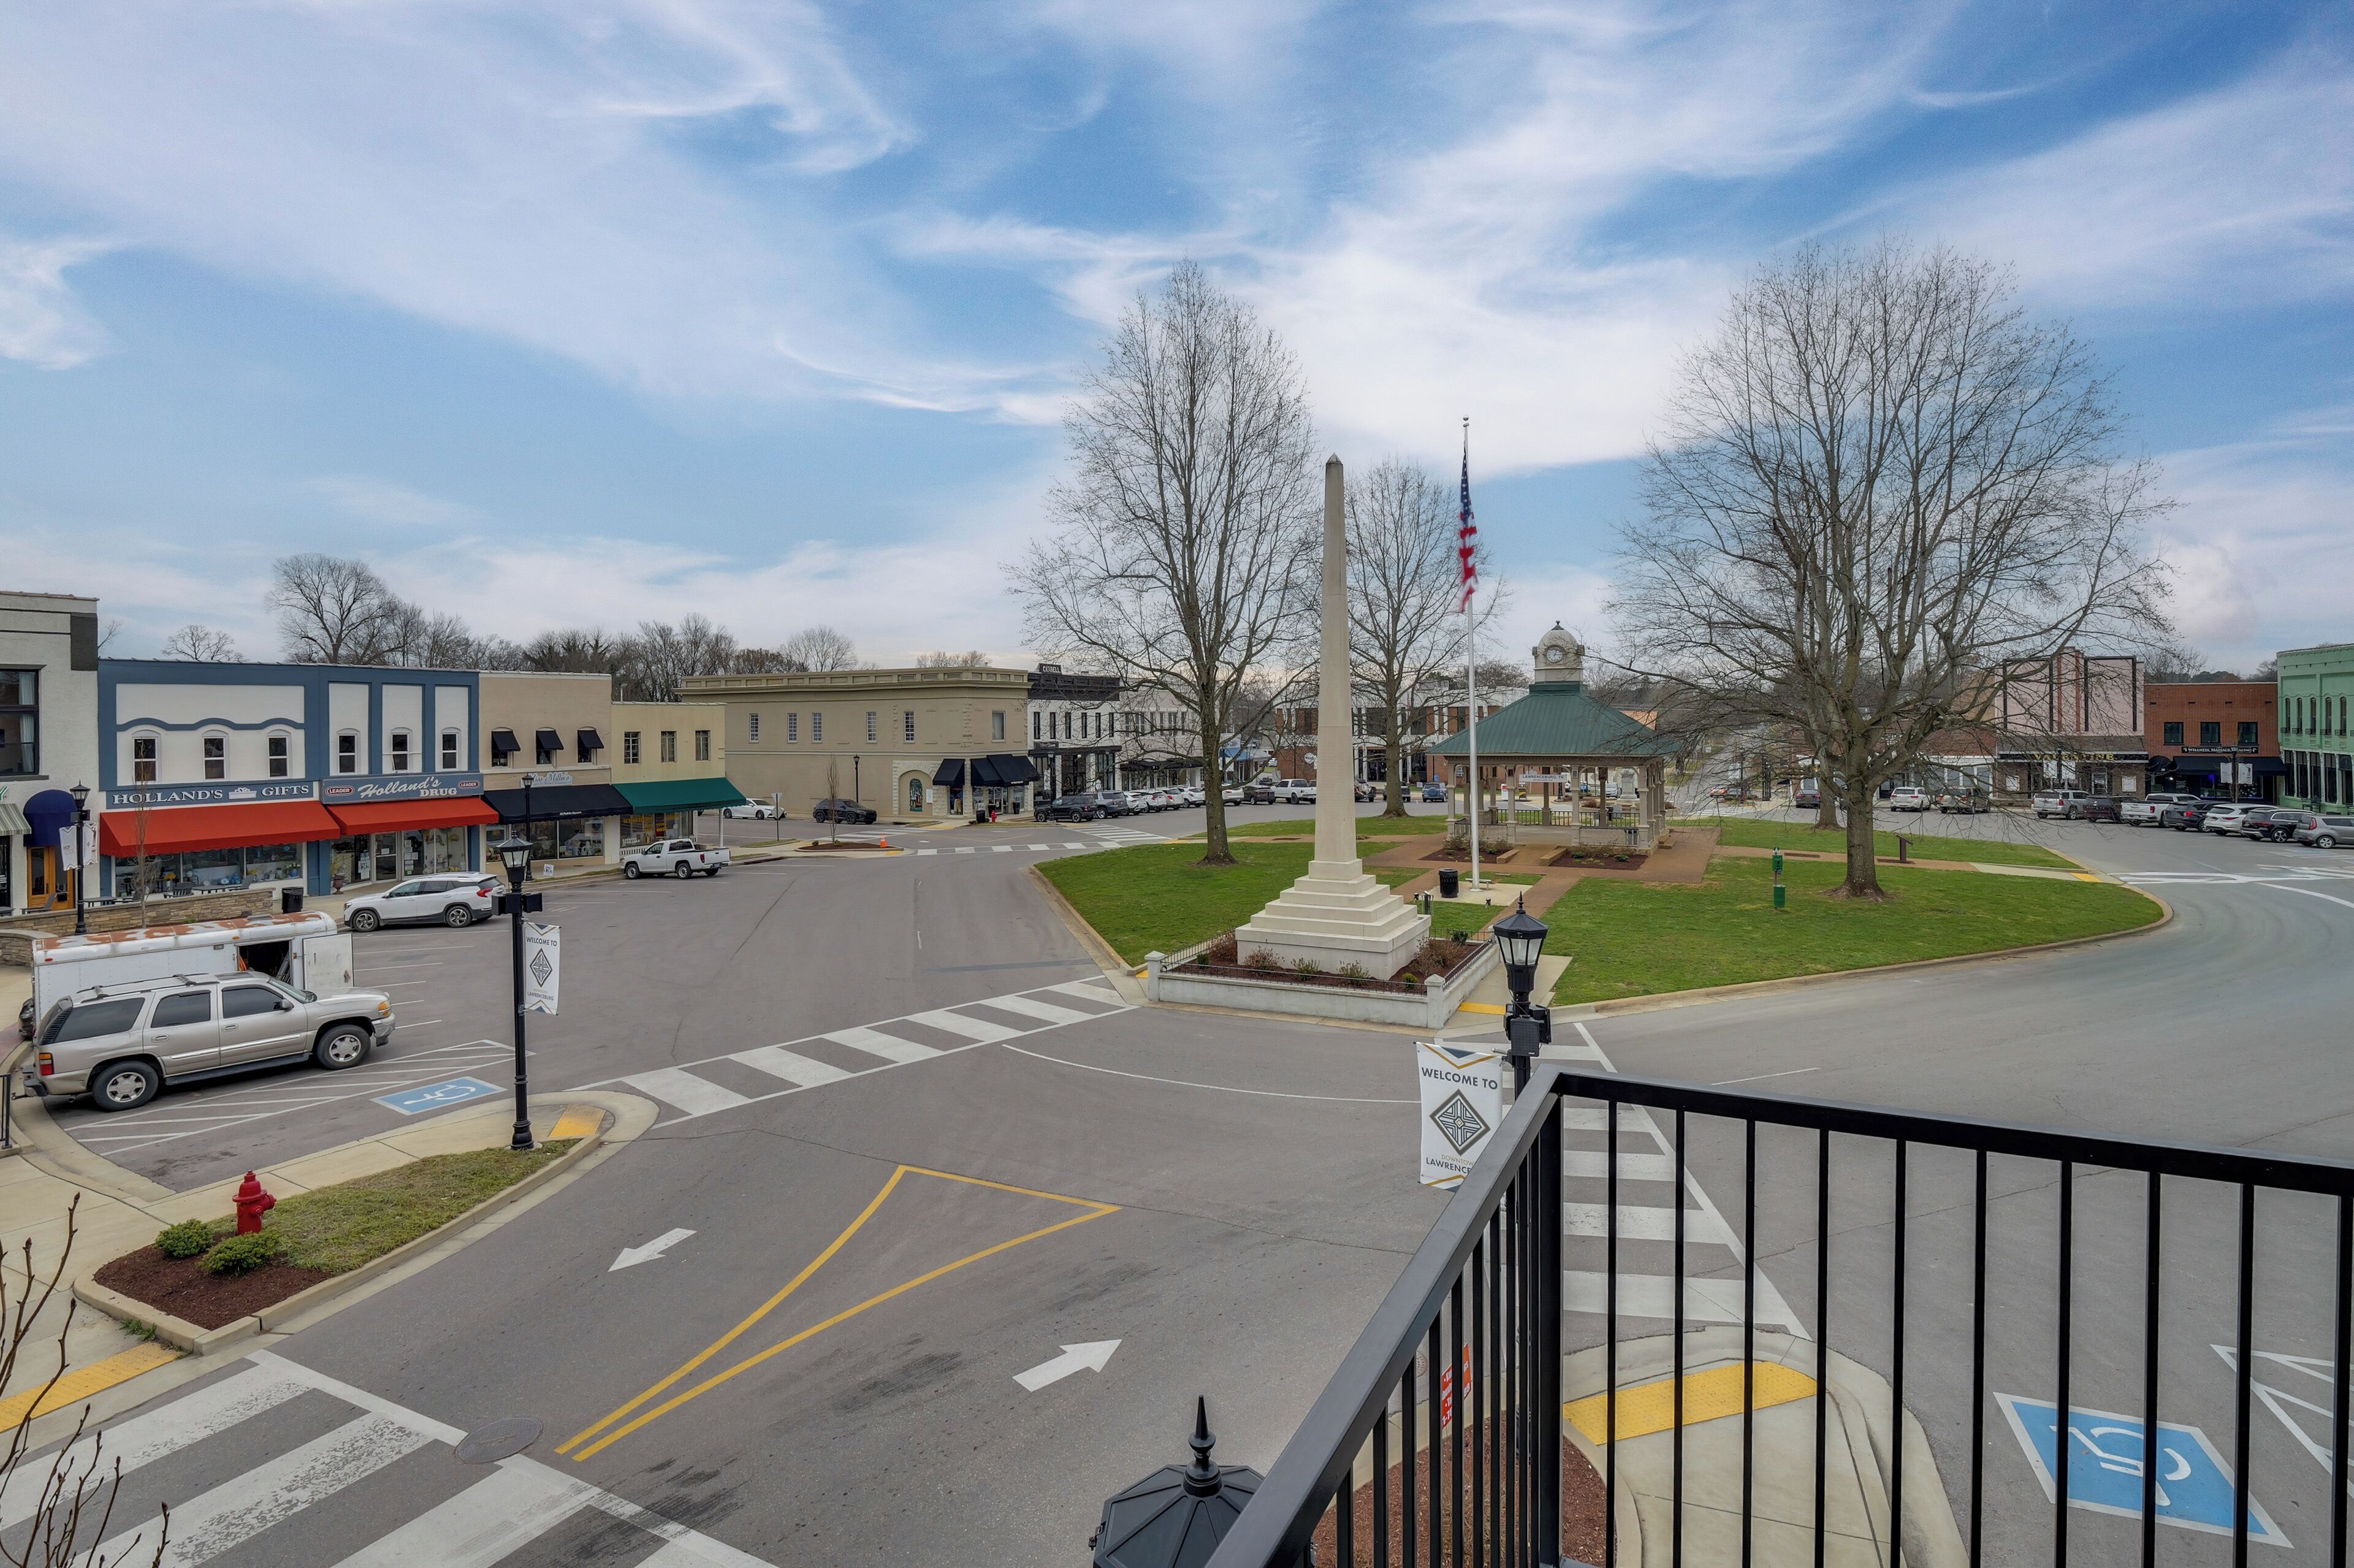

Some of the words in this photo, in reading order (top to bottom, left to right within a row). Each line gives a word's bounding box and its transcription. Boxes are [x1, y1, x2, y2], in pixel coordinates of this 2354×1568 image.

[357, 776, 441, 798] Holland's
[419, 788, 458, 797] DRUG
[112, 789, 223, 804] HOLLAND'S
[261, 785, 310, 796] GIFTS
[526, 936, 549, 946] WELCOME
[527, 991, 554, 1001] LAWRENCEBURG
[1421, 1067, 1478, 1087] WELCOME
[1482, 1078, 1498, 1090] TO
[1426, 1157, 1471, 1174] LAWRENCE
[1441, 1154, 1474, 1166] DOWNTOW
